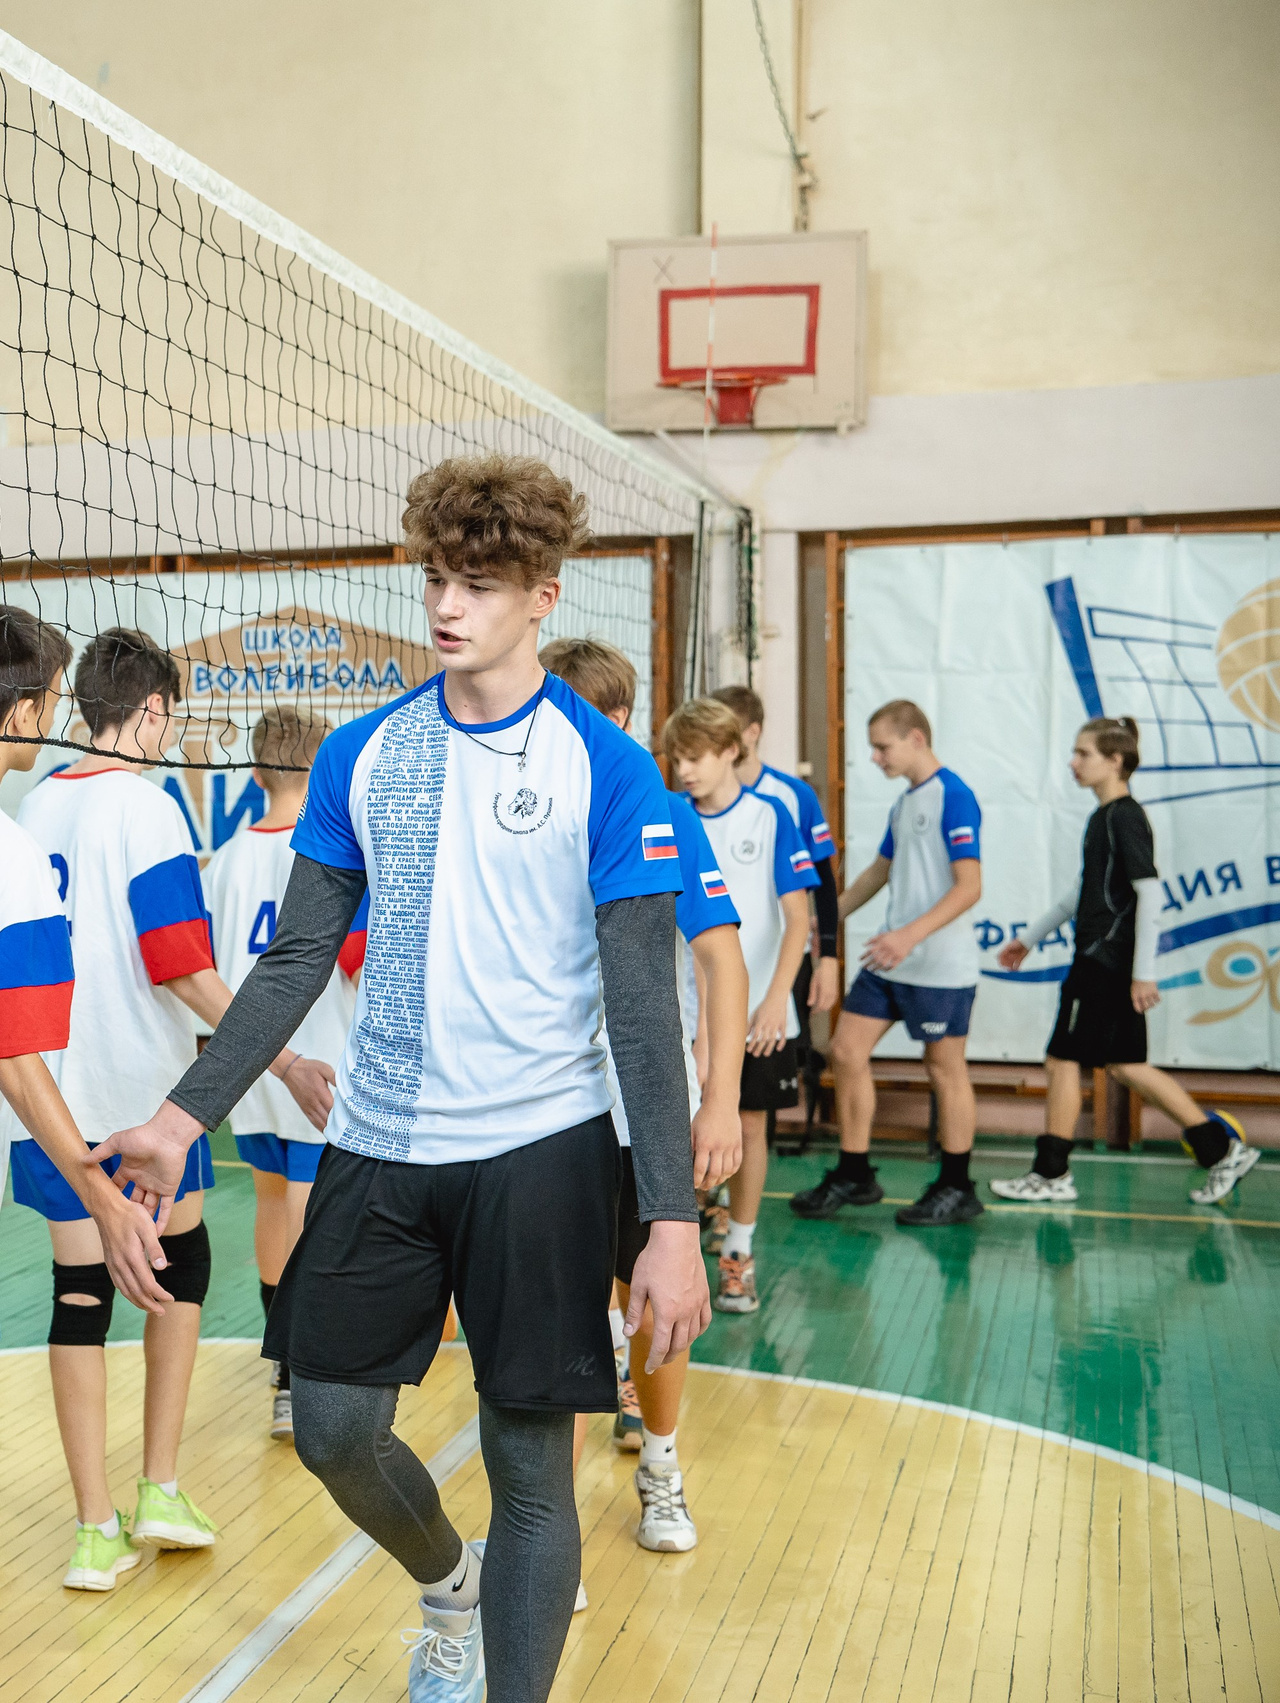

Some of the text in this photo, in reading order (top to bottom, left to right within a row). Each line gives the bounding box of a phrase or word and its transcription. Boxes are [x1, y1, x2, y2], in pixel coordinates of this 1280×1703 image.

[244, 626, 342, 651] ШКОЛА
[195, 653, 407, 693] ВОЛЕЙБОЛА
[409, 786, 423, 794] ВСЕХ
[382, 821, 419, 829] СВОБОДОЮ
